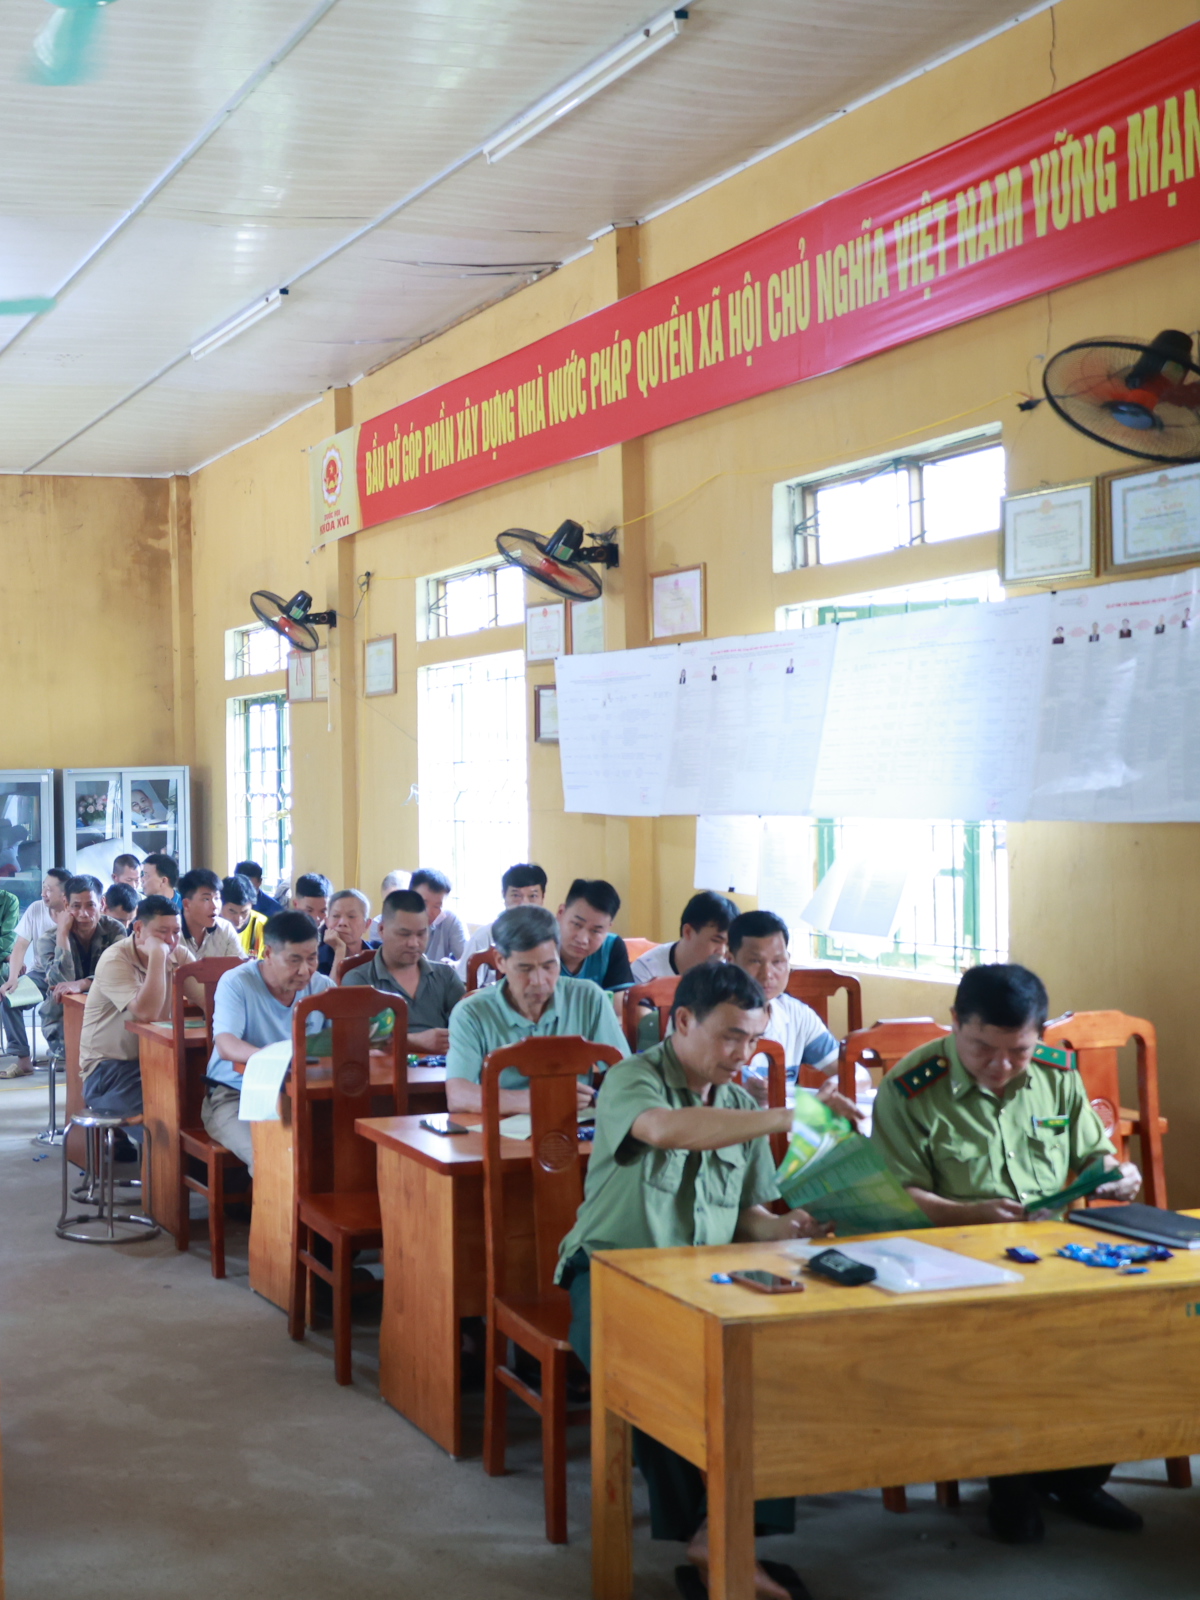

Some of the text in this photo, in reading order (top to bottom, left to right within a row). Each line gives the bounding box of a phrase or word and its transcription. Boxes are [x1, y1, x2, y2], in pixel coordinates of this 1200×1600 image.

[365, 431, 384, 496] BẦU
[386, 423, 402, 489] CỬ
[402, 422, 423, 483] GÓP
[424, 401, 455, 475] PHẦN
[456, 396, 479, 462] XÂY
[481, 388, 516, 461] DỰNG
[517, 364, 546, 438] NHÀ
[548, 349, 587, 427] NƯỚC
[590, 329, 632, 411] PHÁP
[636, 295, 694, 399] QUYỀN
[697, 285, 725, 370] XÃ
[727, 270, 763, 367] HỘI
[767, 236, 811, 343] CHỦ
[815, 216, 890, 324] NGHĨA
[893, 189, 949, 301] VIỆT
[955, 165, 1024, 270] NAM
[1029, 127, 1118, 239] VỮNG
[337, 514, 350, 529] XVI
